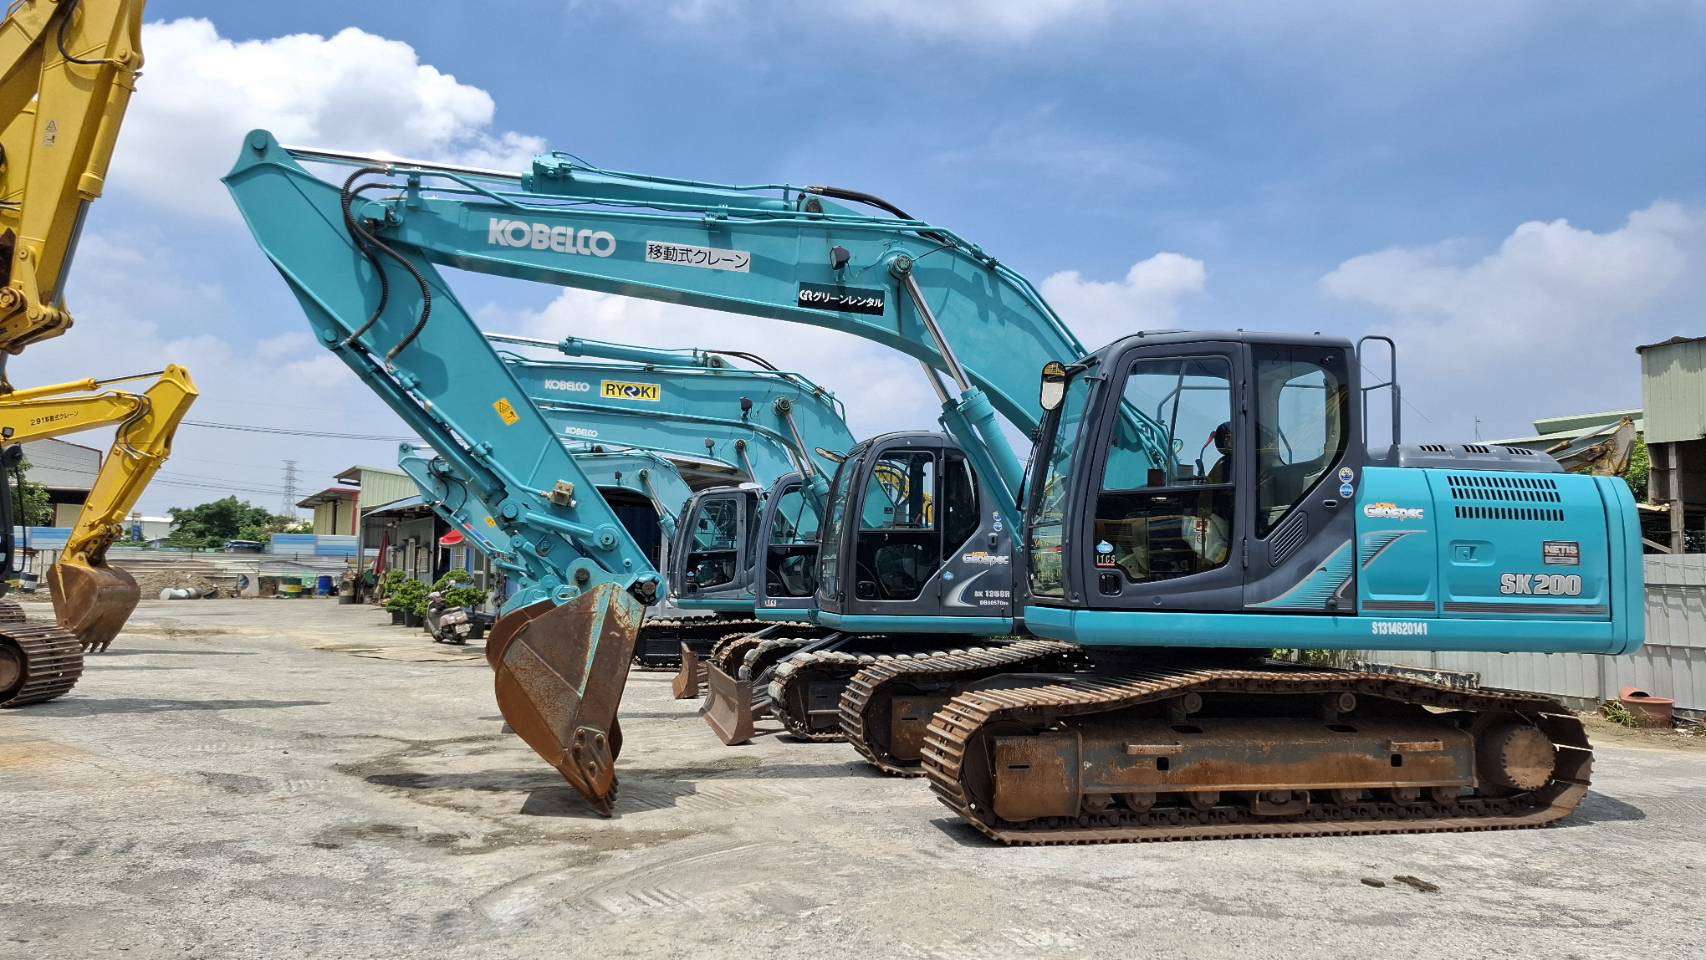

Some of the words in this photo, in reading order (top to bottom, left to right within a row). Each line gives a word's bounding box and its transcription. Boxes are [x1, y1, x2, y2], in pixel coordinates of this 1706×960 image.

[487, 217, 617, 258] KOBELCO
[647, 244, 749, 269] 移動式クレーン
[544, 379, 591, 392] KOBELCO
[605, 383, 657, 399] RYOKI
[564, 426, 599, 438] KOBELCO
[1544, 545, 1578, 555] NETIS
[1500, 573, 1582, 597] SK200
